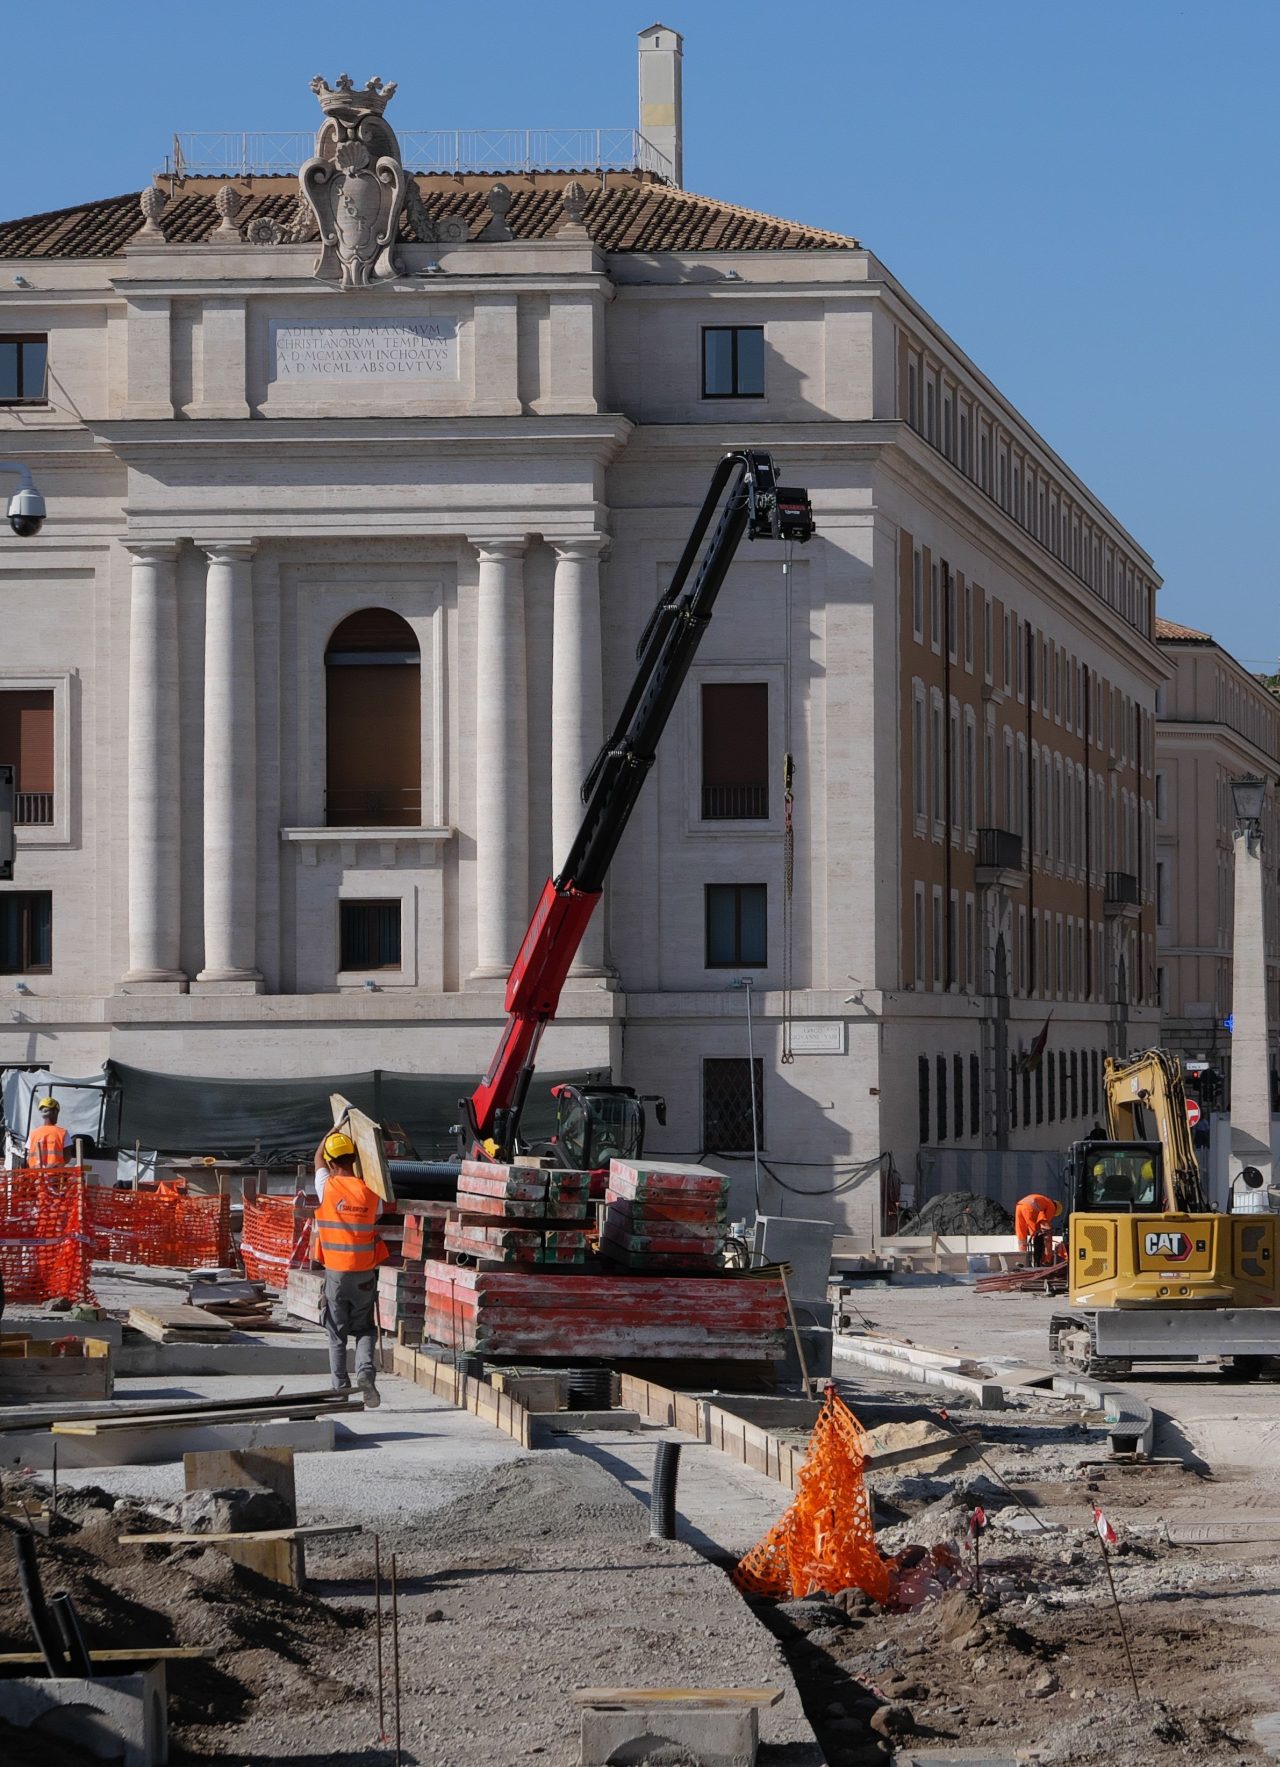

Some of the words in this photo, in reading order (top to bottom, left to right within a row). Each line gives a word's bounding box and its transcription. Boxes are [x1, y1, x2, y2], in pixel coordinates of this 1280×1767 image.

[284, 326, 334, 336] ADITVS
[341, 326, 360, 336] AD
[368, 325, 440, 336] MAXIMVM
[276, 338, 375, 349] CHRISTIANORVM
[384, 337, 448, 348] TEMPLVM
[376, 349, 448, 360] INCHOATVS
[360, 361, 442, 373] ABSOLVTVS
[1145, 1233, 1181, 1255] CAT
